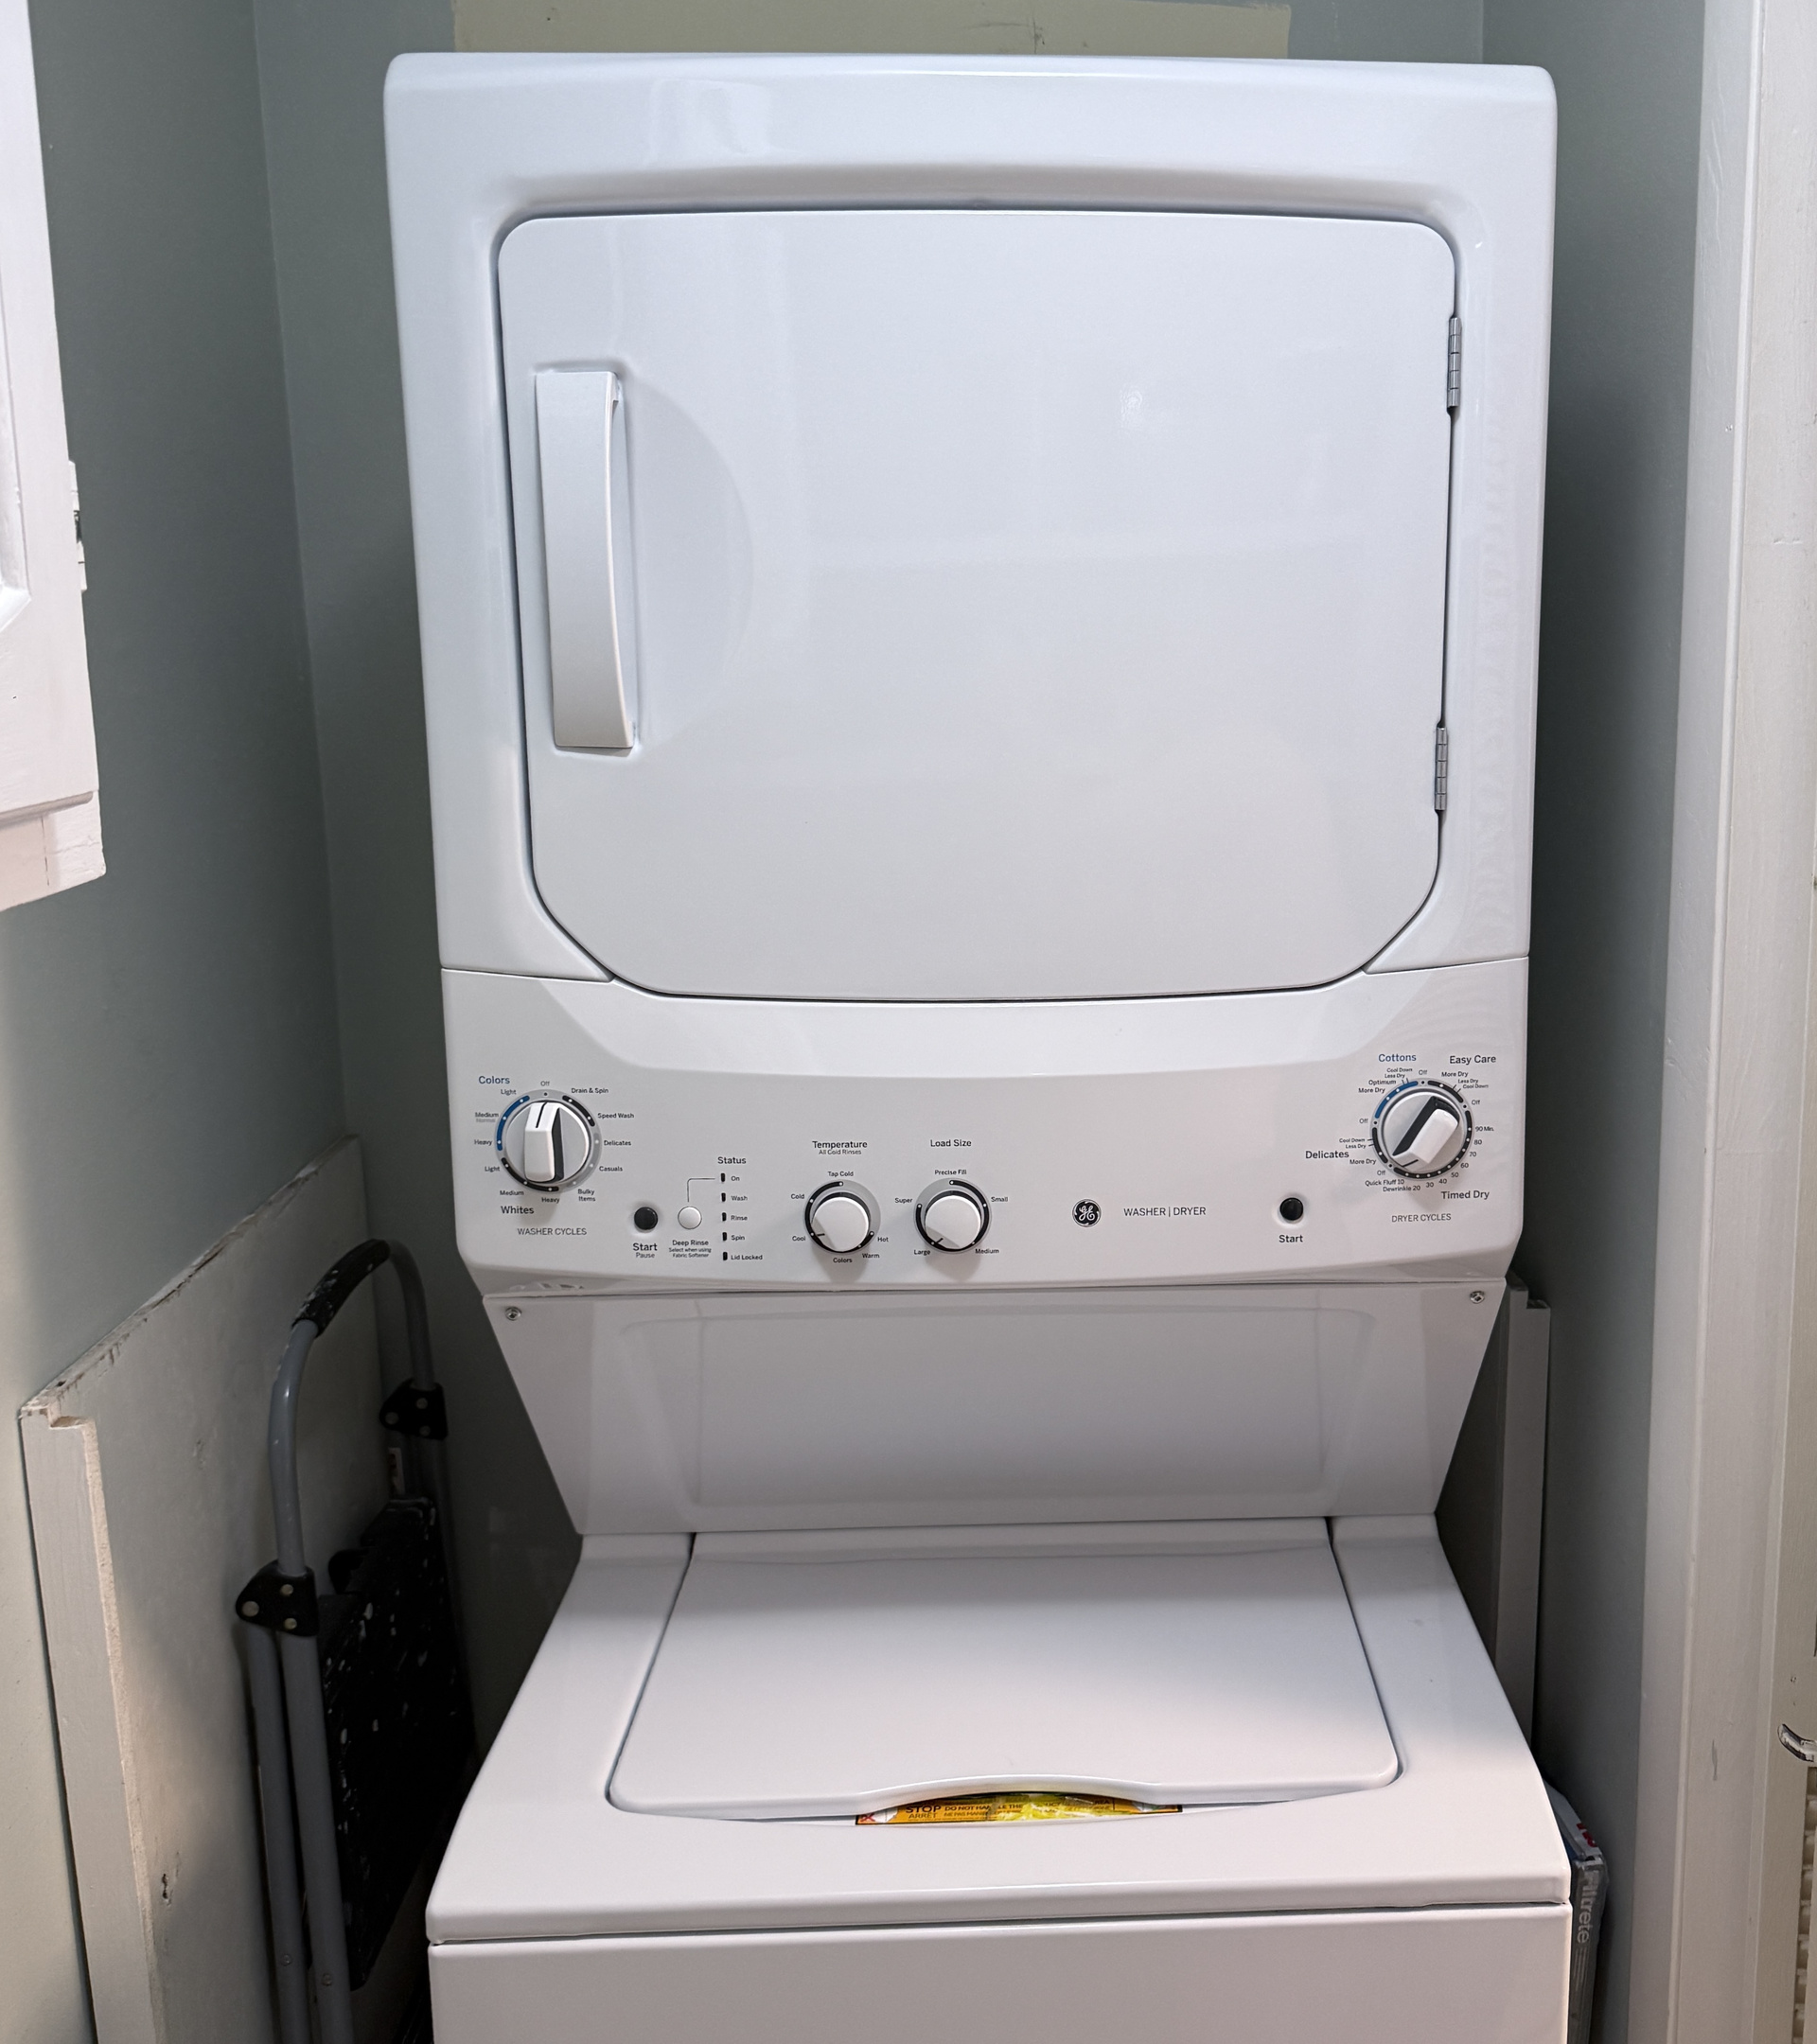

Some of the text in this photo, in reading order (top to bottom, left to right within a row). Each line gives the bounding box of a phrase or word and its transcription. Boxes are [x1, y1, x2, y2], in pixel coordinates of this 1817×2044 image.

[1378, 1054, 1417, 1062] Cottons
[1449, 1056, 1472, 1065] Easy
[478, 1076, 510, 1084] Colors
[812, 1141, 867, 1150] Temperature
[1305, 1151, 1349, 1159] Delicates
[1473, 1190, 1490, 1200] Dry
[501, 1206, 534, 1214] Whites
[1124, 1207, 1206, 1216] WASHER DRYER
[1420, 1213, 1451, 1221] CYCLES
[1279, 1234, 1303, 1243] Start
[633, 1243, 657, 1251] Start
[906, 1805, 941, 1813] STOP
